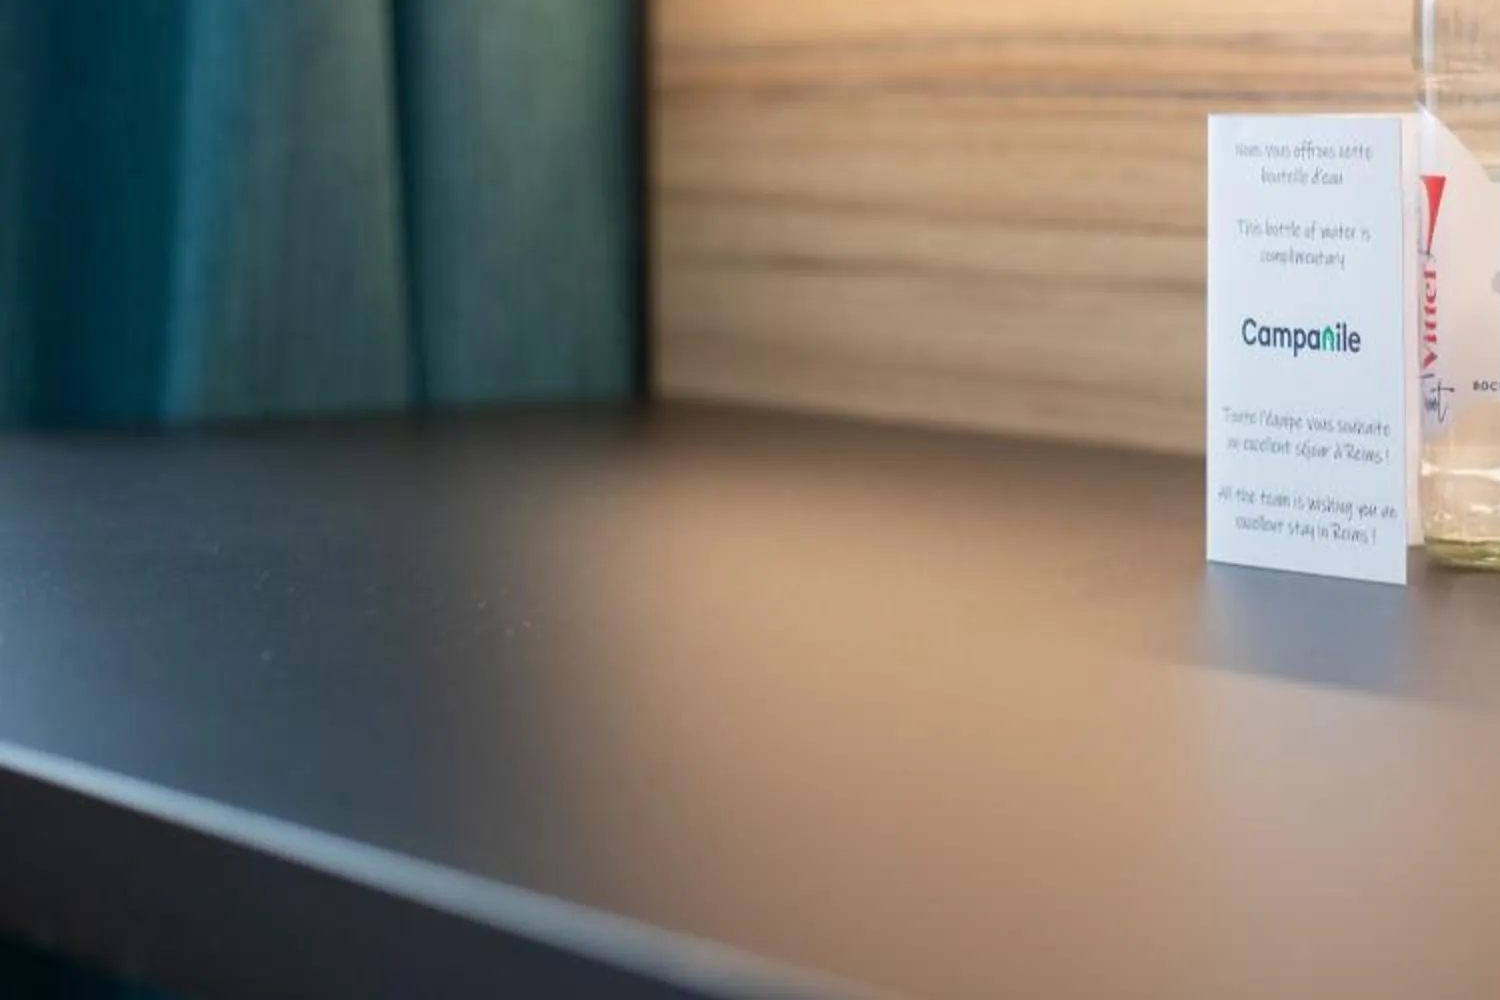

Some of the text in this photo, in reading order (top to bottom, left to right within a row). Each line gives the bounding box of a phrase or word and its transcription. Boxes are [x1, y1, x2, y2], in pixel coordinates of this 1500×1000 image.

[1293, 140, 1336, 160] offrons
[1265, 219, 1301, 237] bottle
[1303, 220, 1318, 241] of
[1321, 223, 1356, 241] water
[1241, 317, 1361, 356] Campanile
[1222, 407, 1257, 425] Toute
[1336, 418, 1391, 437] souhaite
[1243, 437, 1291, 456] excellent
[1295, 439, 1331, 462] séjour
[1235, 488, 1256, 504] the
[1260, 490, 1293, 508] team
[1293, 496, 1304, 510] is
[1307, 496, 1353, 521] wishing
[1357, 503, 1377, 520] you
[1235, 515, 1285, 533] excellent
[1288, 521, 1315, 542] stay
